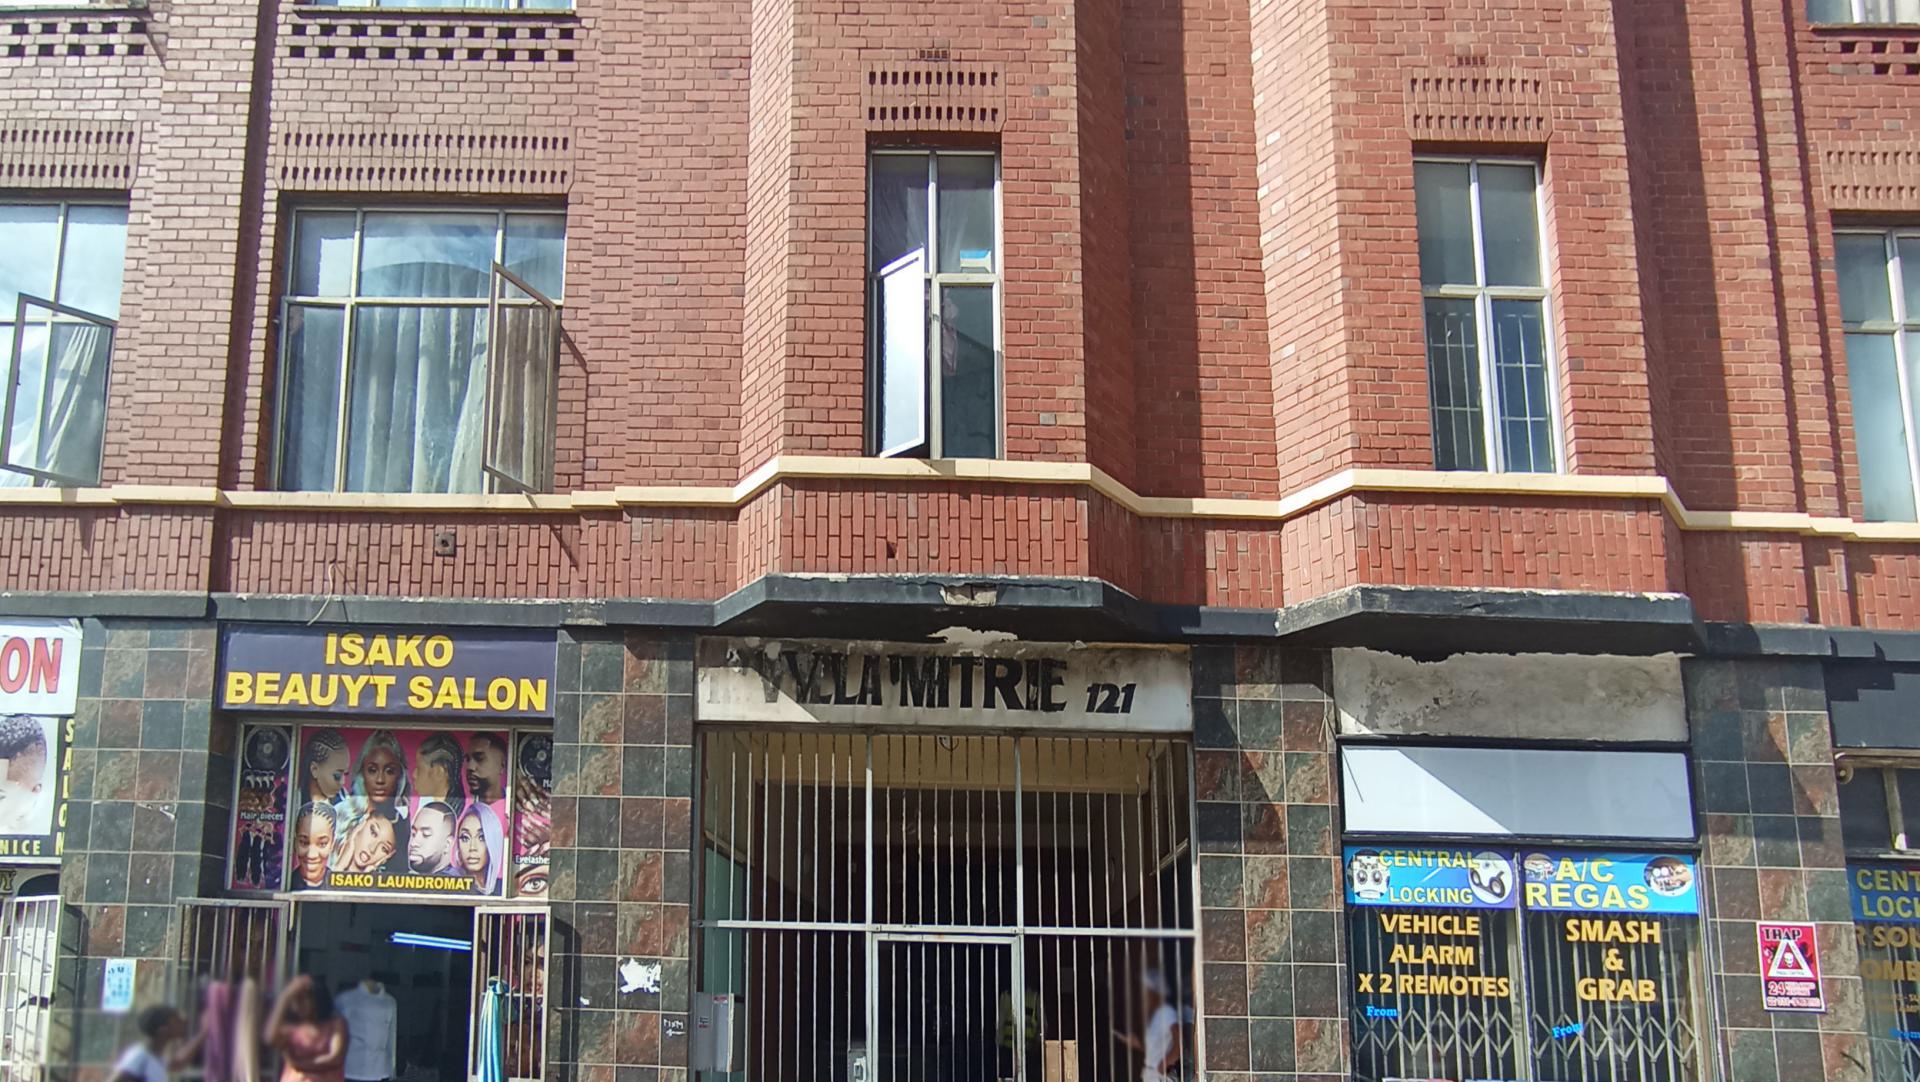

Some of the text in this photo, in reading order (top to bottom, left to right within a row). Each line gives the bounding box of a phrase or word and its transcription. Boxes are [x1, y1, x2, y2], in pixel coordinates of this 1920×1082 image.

[324, 633, 454, 668] ISAKO
[225, 671, 548, 712] BEAUYT SALON
[1086, 683, 1137, 714] 121
[515, 855, 551, 865] Eyelashe
[1379, 850, 1480, 869] CENTRAL
[1555, 858, 1614, 883] A/C
[330, 873, 473, 891] ISAKO LAUNDROMAT
[1388, 886, 1474, 904] LOCKING
[1525, 882, 1650, 909] REGAS
[1381, 914, 1481, 936] VEHICLE
[1566, 919, 1661, 943] SMASH
[1762, 927, 1802, 941] TRAP
[1389, 944, 1474, 966] ALARM
[1605, 948, 1625, 971] &
[1358, 973, 1510, 997] X 2 REMOTES
[1577, 978, 1657, 1001] GRAB
[1366, 1004, 1399, 1018] From
[1552, 1023, 1584, 1039] From
